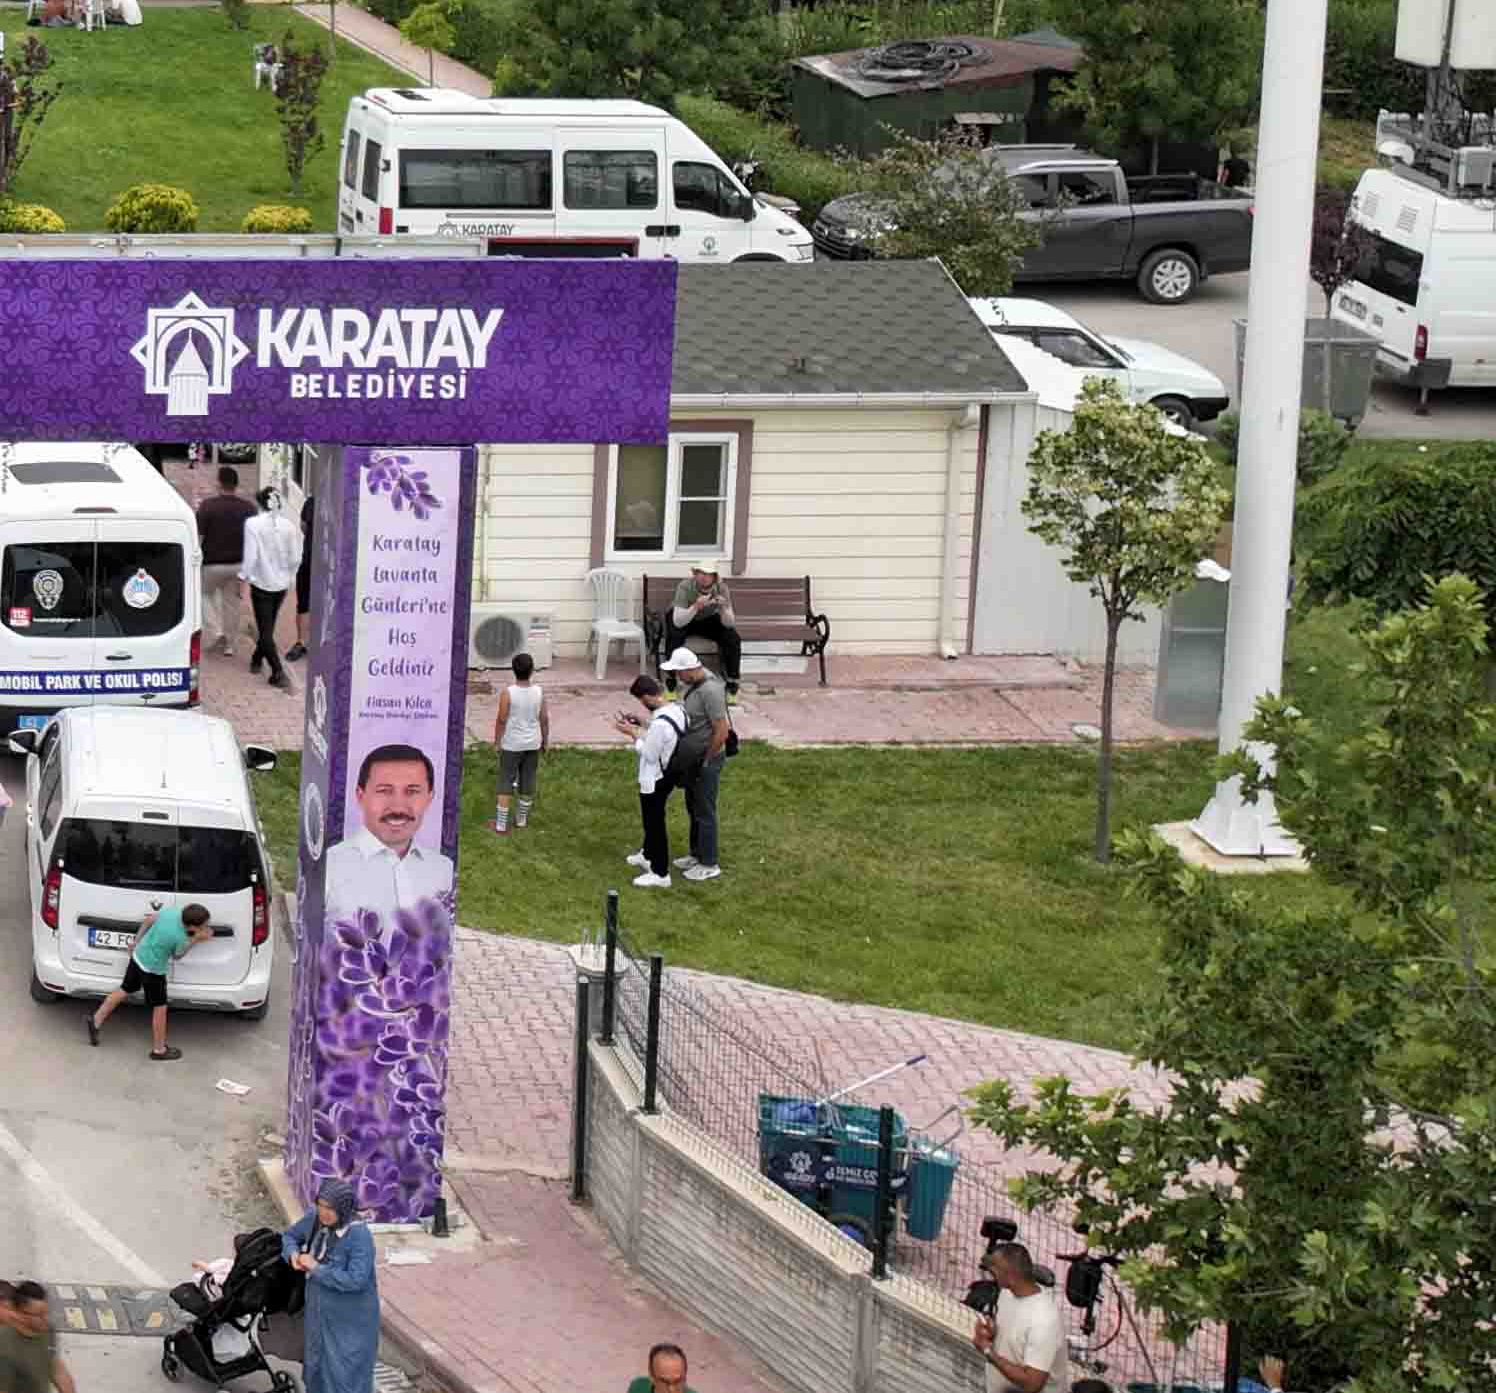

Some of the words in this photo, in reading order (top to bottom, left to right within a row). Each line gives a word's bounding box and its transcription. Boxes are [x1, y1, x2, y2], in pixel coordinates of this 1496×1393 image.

[462, 224, 515, 236] KARATAY
[256, 307, 505, 369] KARATAY
[290, 367, 467, 399] BELEDİYESİ
[372, 534, 441, 557] Karatay
[373, 566, 438, 584] Lavanta
[361, 595, 448, 615] Günleri'ne
[388, 628, 417, 648] Hoş
[368, 658, 435, 677] Geldiniz
[45, 674, 83, 689] PARK
[83, 674, 102, 689] VE
[105, 673, 140, 689] OKUL
[97, 932, 112, 945] 42
